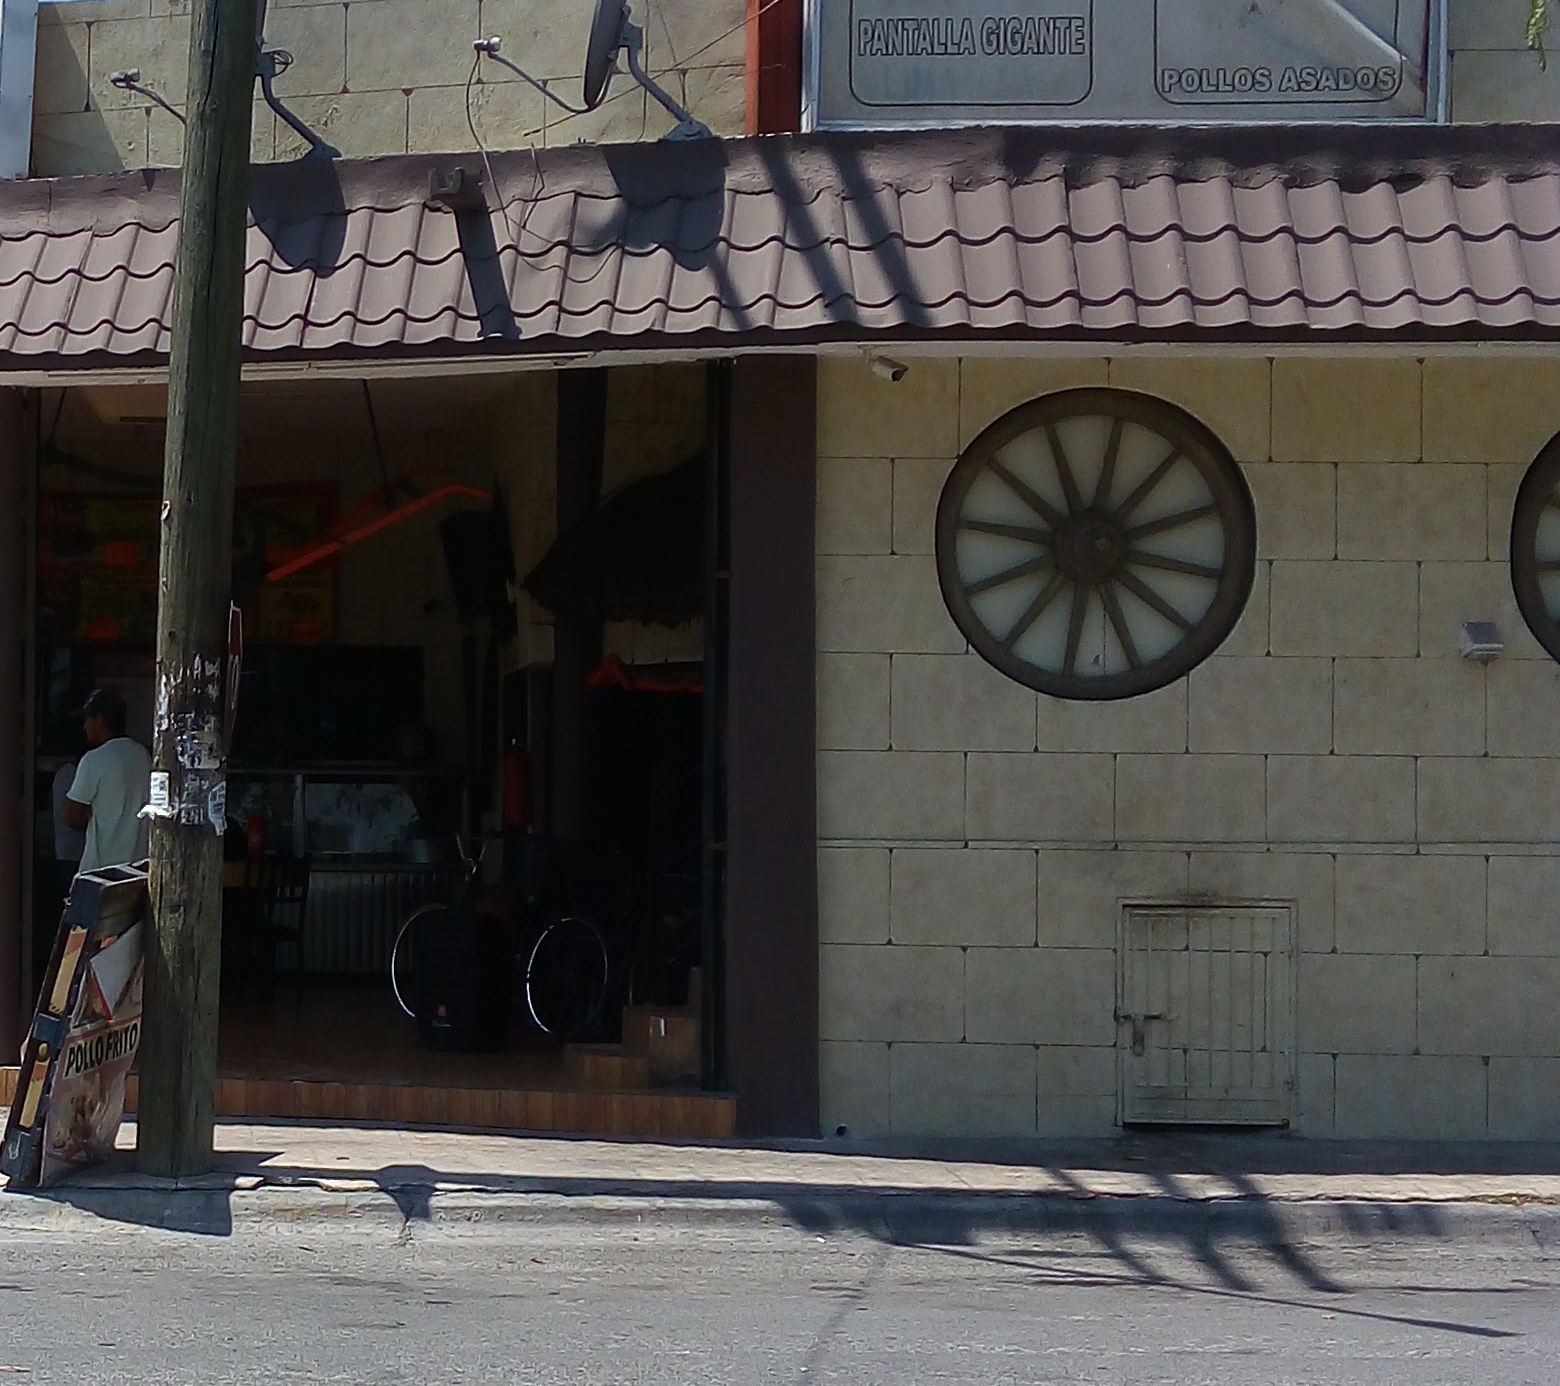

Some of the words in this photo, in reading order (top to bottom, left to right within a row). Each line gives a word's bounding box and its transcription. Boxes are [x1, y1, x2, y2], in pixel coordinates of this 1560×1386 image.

[857, 17, 976, 57] PANTALLA
[980, 16, 1086, 56] GIGANTE
[1161, 66, 1273, 94] POLLOS
[1277, 66, 1398, 93] ASADOS
[65, 1034, 103, 1077] POLLO
[103, 1021, 139, 1062] FRITO
